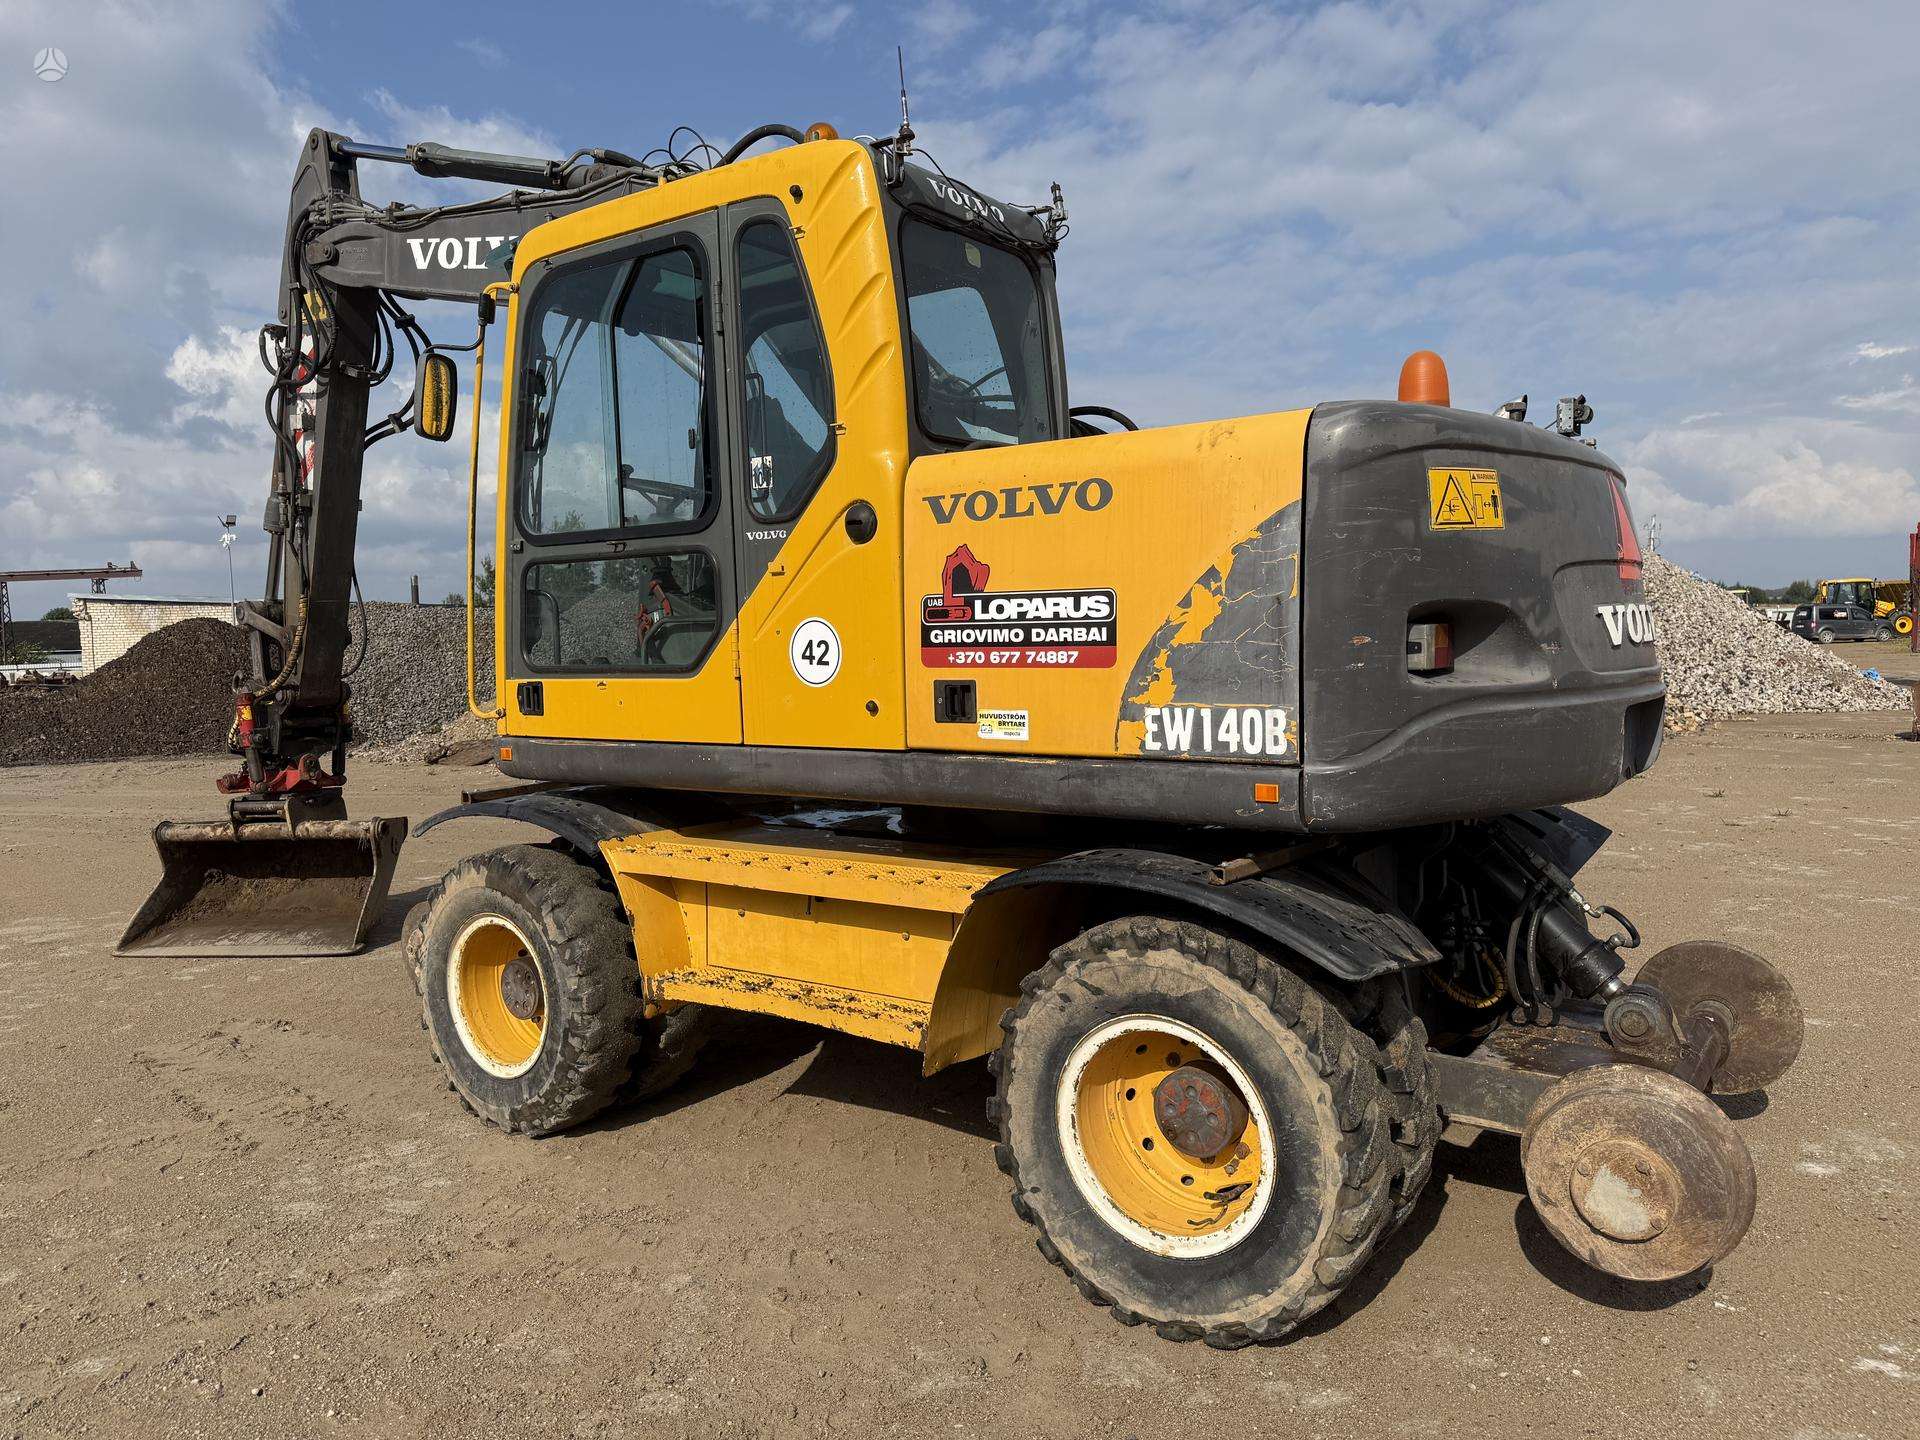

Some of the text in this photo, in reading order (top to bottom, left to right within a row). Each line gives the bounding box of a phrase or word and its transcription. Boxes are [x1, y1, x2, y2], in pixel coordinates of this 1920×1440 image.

[926, 177, 1004, 222] VOLVO
[922, 477, 1114, 525] VOLVO
[746, 529, 787, 541] VOLVO
[927, 599, 943, 607] UAB
[974, 595, 1111, 621] LOPARUS
[929, 626, 1108, 644] GRIOVIMO DARBAI
[801, 639, 830, 666] 42
[947, 650, 1079, 664] +370 677 74887
[1143, 707, 1288, 755] EW140B
